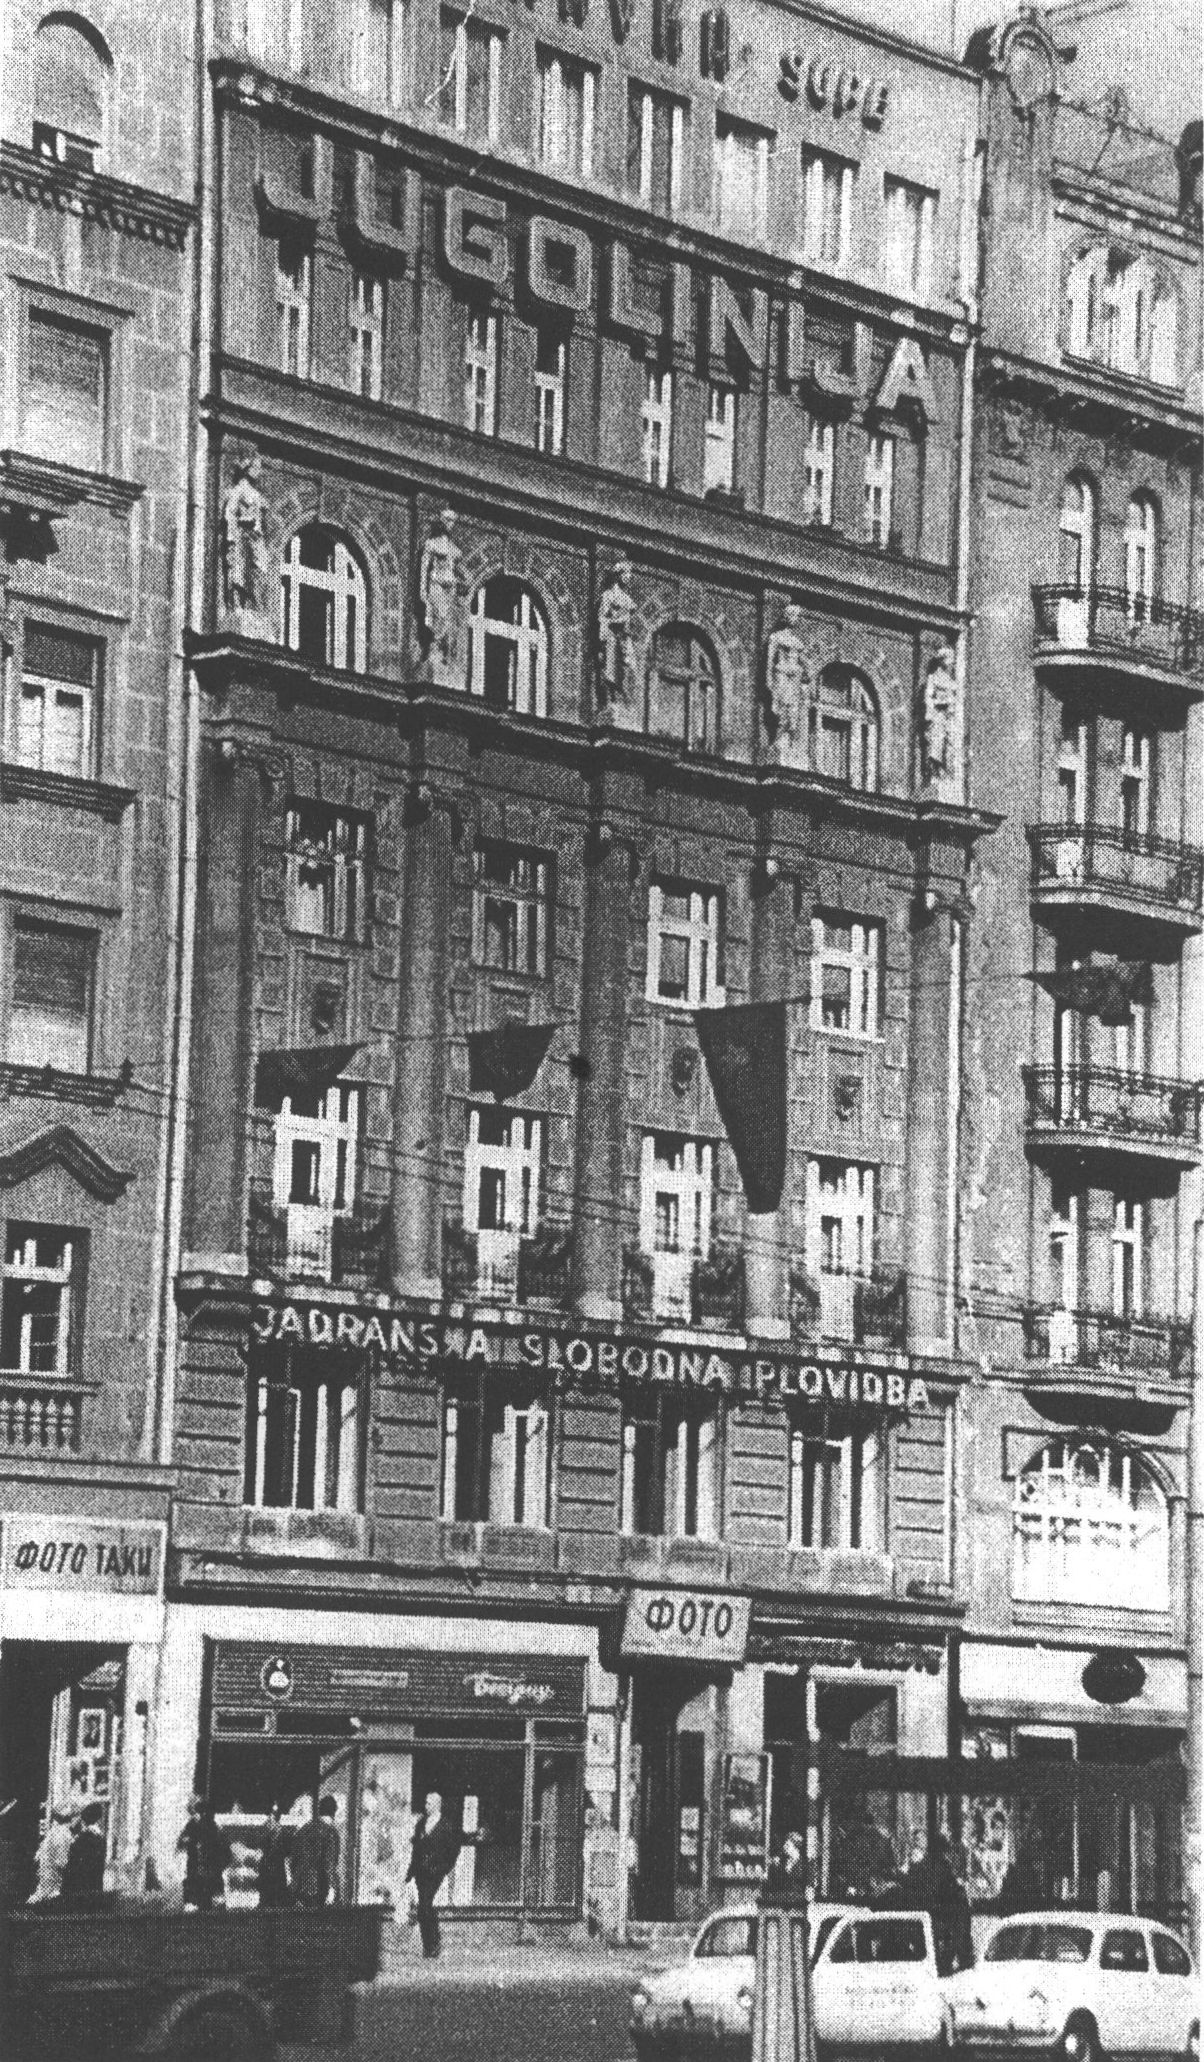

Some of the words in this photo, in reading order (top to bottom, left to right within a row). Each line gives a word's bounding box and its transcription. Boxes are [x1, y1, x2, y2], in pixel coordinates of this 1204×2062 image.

[260, 133, 940, 420] JUGOLINIJA
[252, 1304, 490, 1362] JADRANSKA
[523, 1334, 730, 1389] SLOBODNA
[755, 1360, 929, 1410] PLOVIDBA
[14, 1540, 88, 1575] ФОТО
[645, 1597, 733, 1639] ФОТО
